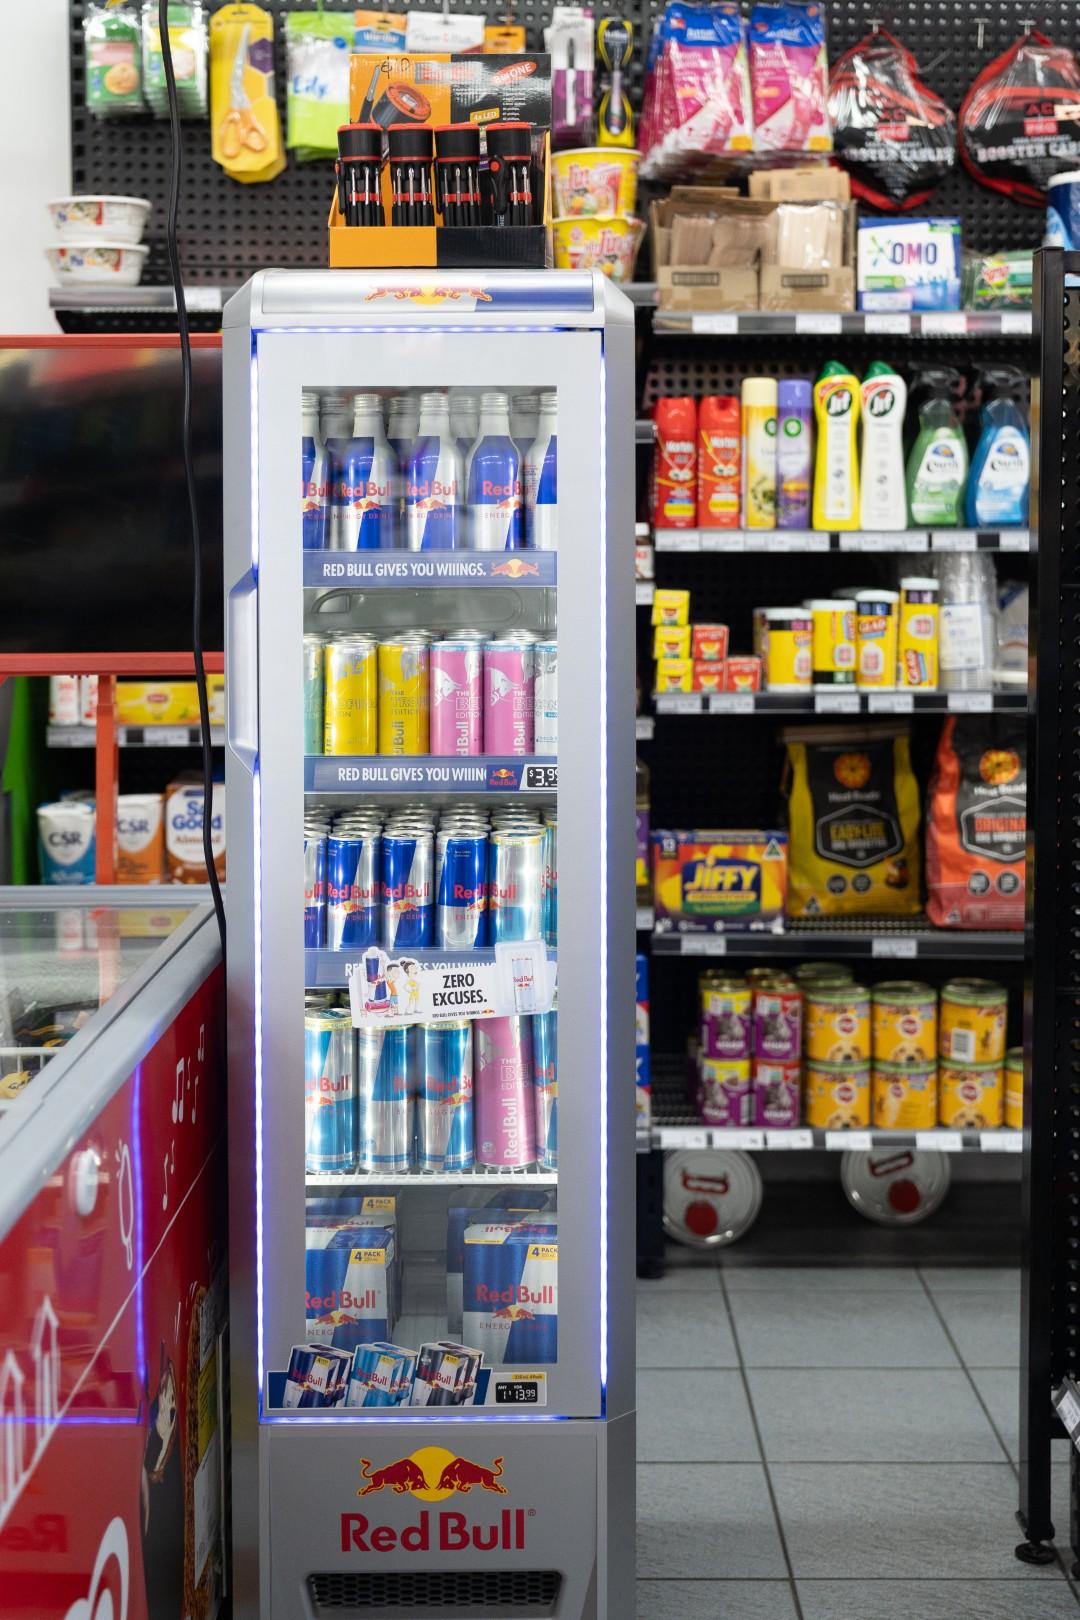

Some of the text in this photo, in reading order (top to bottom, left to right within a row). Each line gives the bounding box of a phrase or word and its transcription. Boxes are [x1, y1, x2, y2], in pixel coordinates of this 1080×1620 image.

[891, 242, 937, 265] OMO
[367, 481, 391, 497] Bull
[432, 480, 458, 497] Bull
[482, 480, 513, 497] Red
[323, 563, 345, 577] RED
[347, 563, 374, 577] BULL
[375, 563, 408, 577] GIVES
[411, 563, 434, 576] YOU
[455, 721, 469, 747] Bull
[513, 721, 526, 747] Bull
[338, 767, 360, 781] RED
[362, 767, 388, 781] BULL
[391, 767, 423, 781] GIVES
[426, 767, 450, 781] YOU
[118, 819, 149, 834] CSR
[48, 831, 82, 847] CSR
[405, 882, 430, 898] Bull
[453, 883, 482, 899] Red
[443, 973, 475, 989] ZERO
[433, 989, 488, 1007] EXCUSES.
[319, 1075, 349, 1092] Bull
[501, 1097, 519, 1158] Red Bull
[366, 1199, 375, 1209] 4
[354, 1251, 362, 1262] 4
[532, 1247, 540, 1257] 4
[340, 1290, 376, 1308] Bull
[475, 1284, 553, 1304] Red Bull
[307, 1374, 323, 1387] Bull
[372, 1373, 387, 1386] Bull
[436, 1371, 452, 1386] Bull
[340, 1508, 525, 1553] Red Bull
